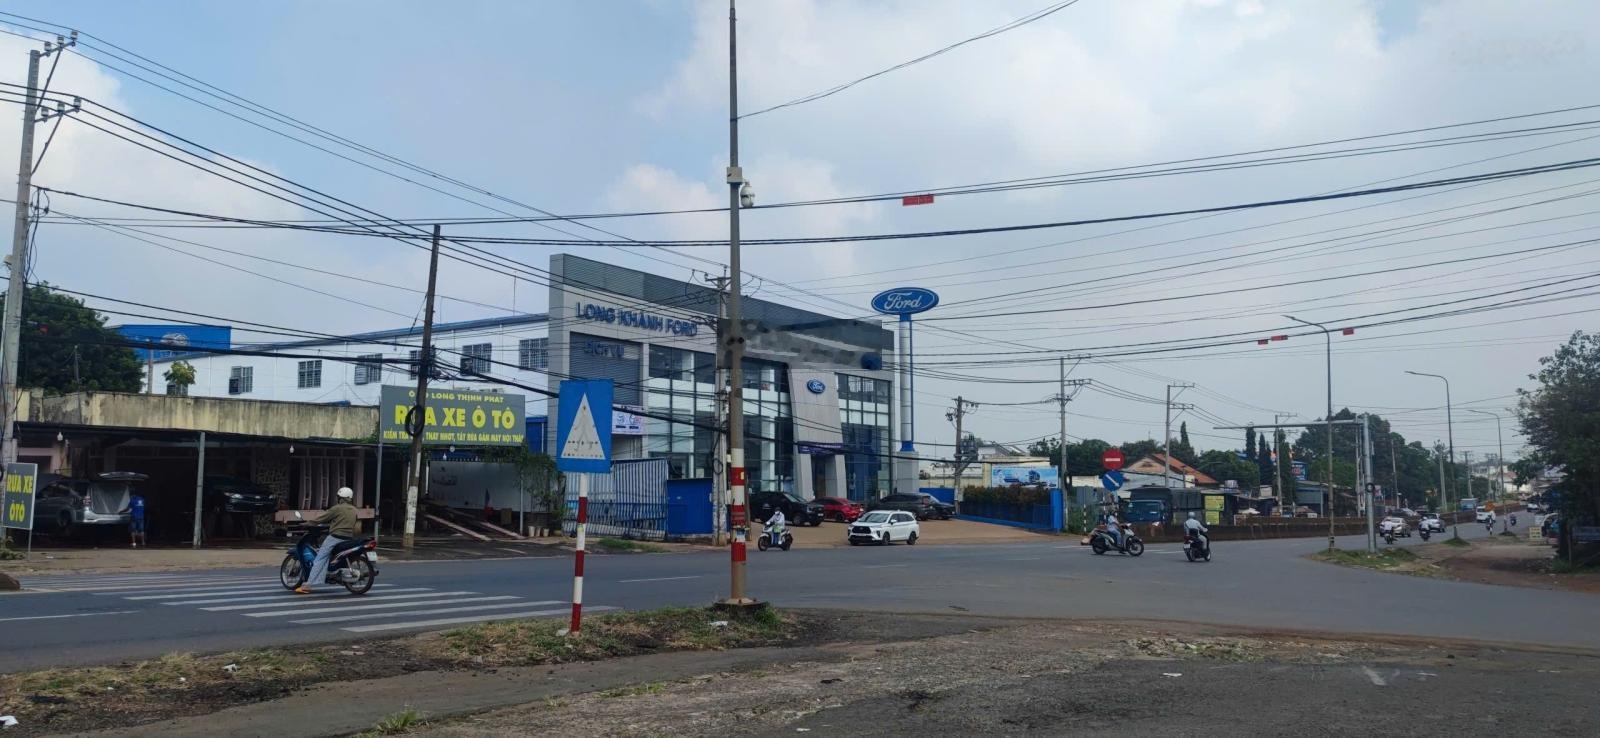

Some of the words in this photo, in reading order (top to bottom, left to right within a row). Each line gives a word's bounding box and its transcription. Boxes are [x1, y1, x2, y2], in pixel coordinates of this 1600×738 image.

[884, 292, 922, 310] Ford
[576, 302, 615, 324] LONG
[665, 318, 697, 336] FORD
[431, 392, 455, 400] LONG
[394, 400, 437, 426] RA
[442, 407, 466, 427] XE
[472, 405, 486, 428] Ô
[491, 406, 515, 430] TÔ
[23, 475, 33, 494] XE
